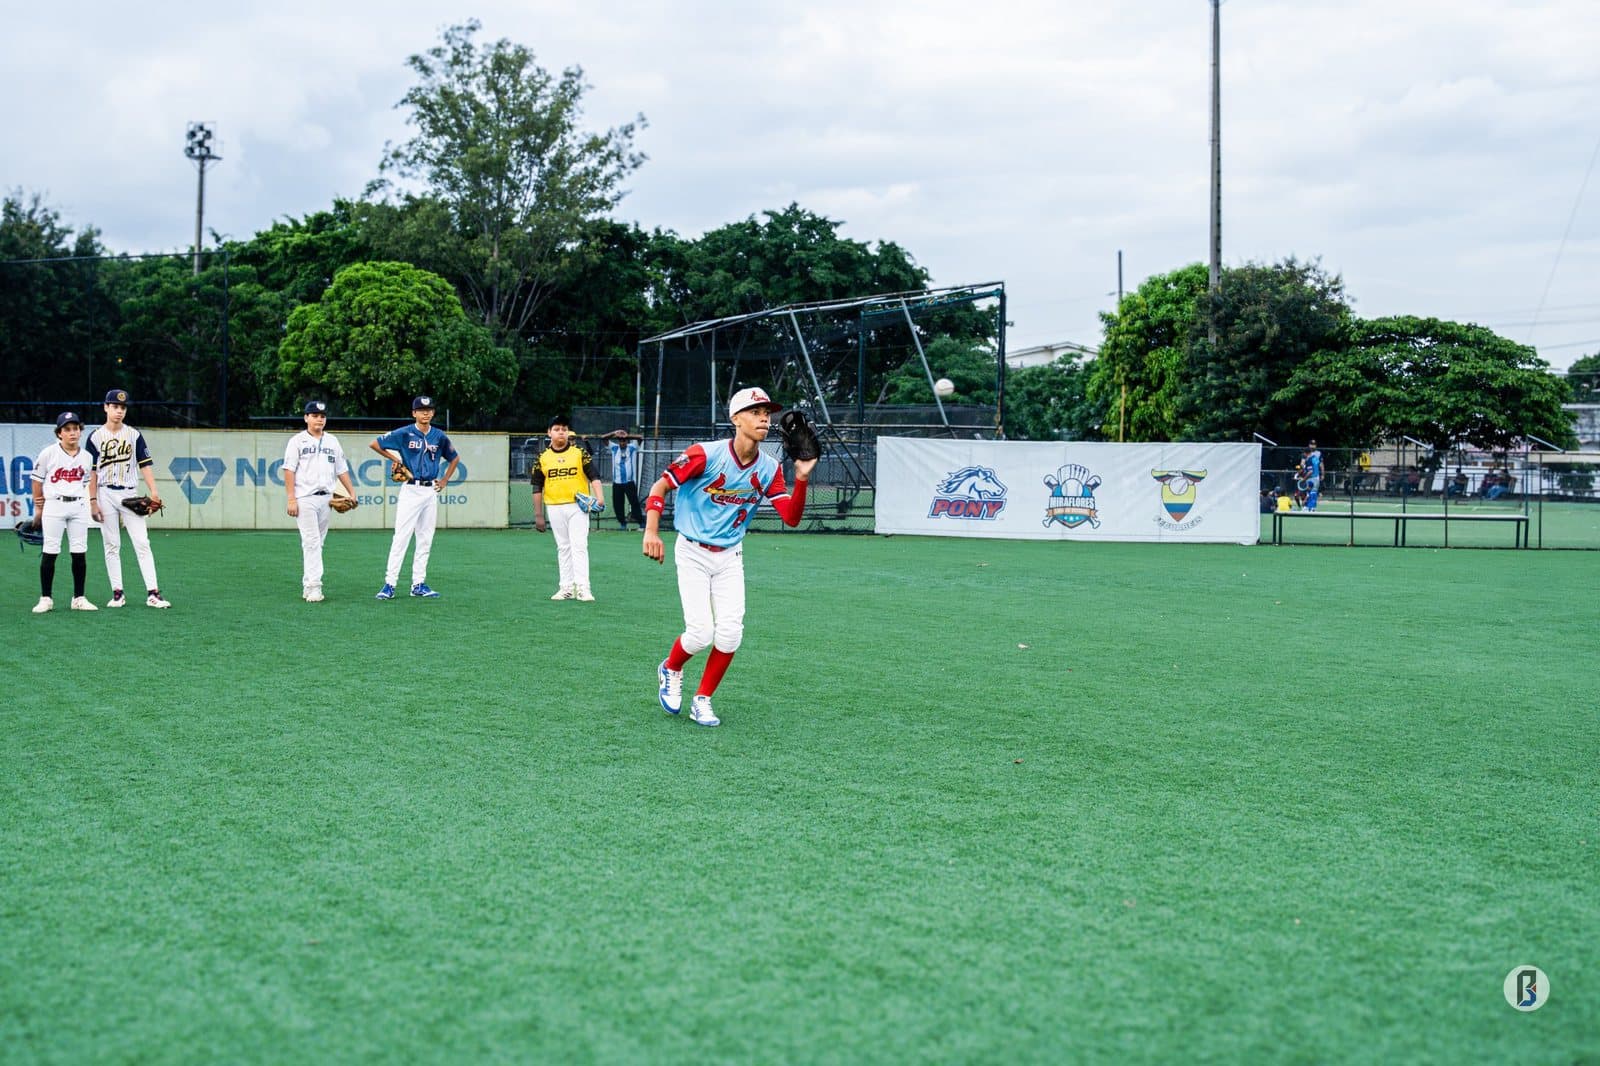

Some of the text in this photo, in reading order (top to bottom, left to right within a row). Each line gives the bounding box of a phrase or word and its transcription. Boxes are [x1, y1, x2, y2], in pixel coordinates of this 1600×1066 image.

[547, 467, 578, 478] BSC
[931, 498, 1004, 518] PONY
[1049, 496, 1095, 509] MIRAFLORES
[733, 508, 748, 529] 2
